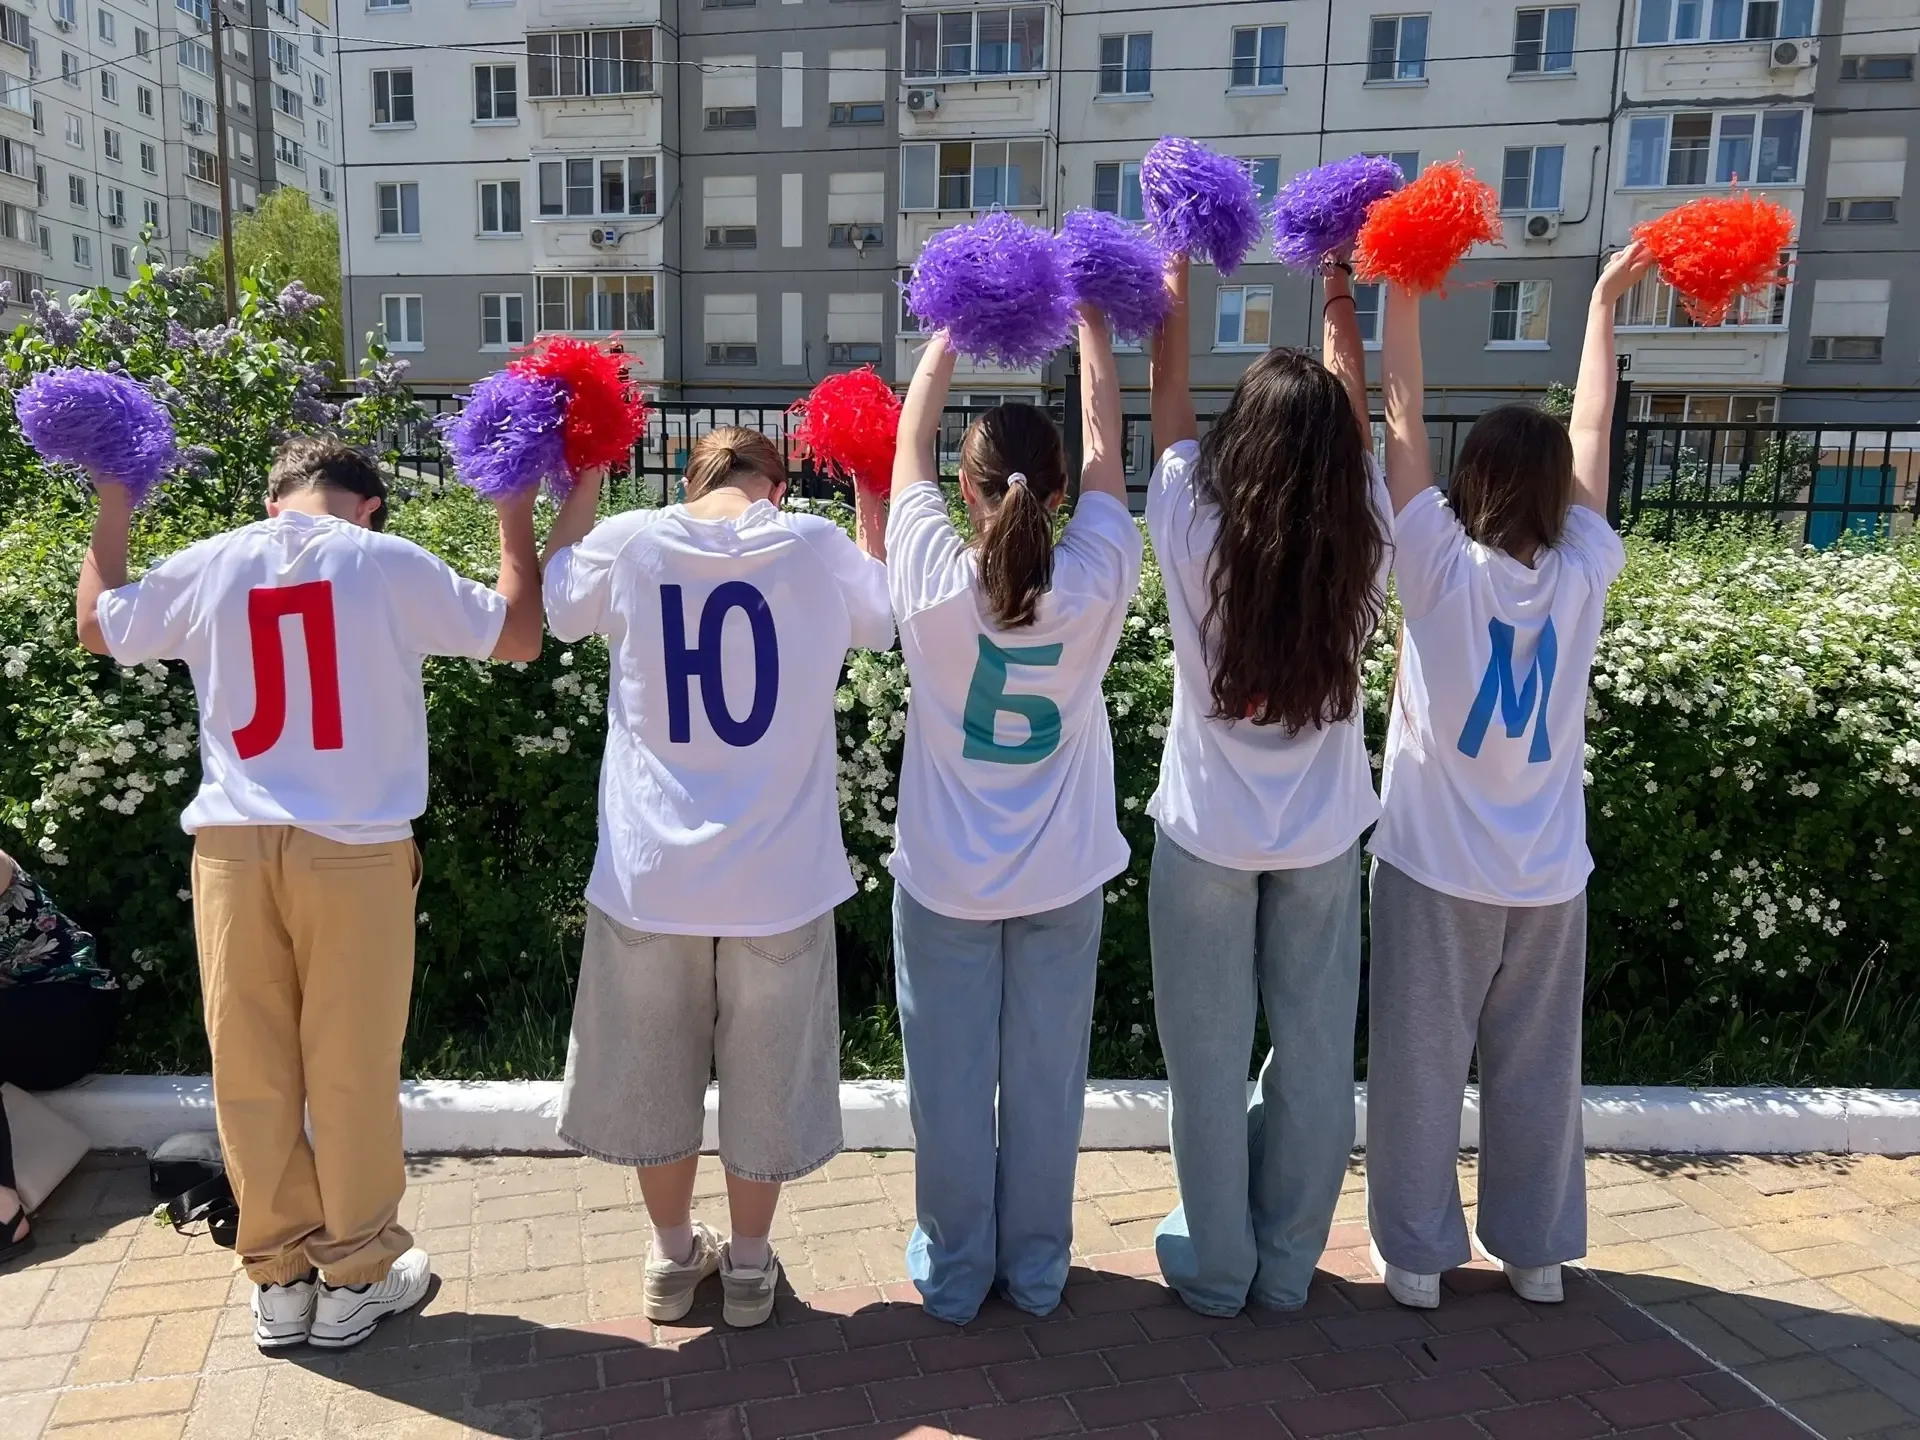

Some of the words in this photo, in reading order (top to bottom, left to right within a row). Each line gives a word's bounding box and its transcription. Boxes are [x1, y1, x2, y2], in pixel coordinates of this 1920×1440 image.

[231, 580, 344, 760] Л
[660, 580, 779, 747] Ю
[962, 633, 1064, 765] Б
[1457, 615, 1558, 763] М
